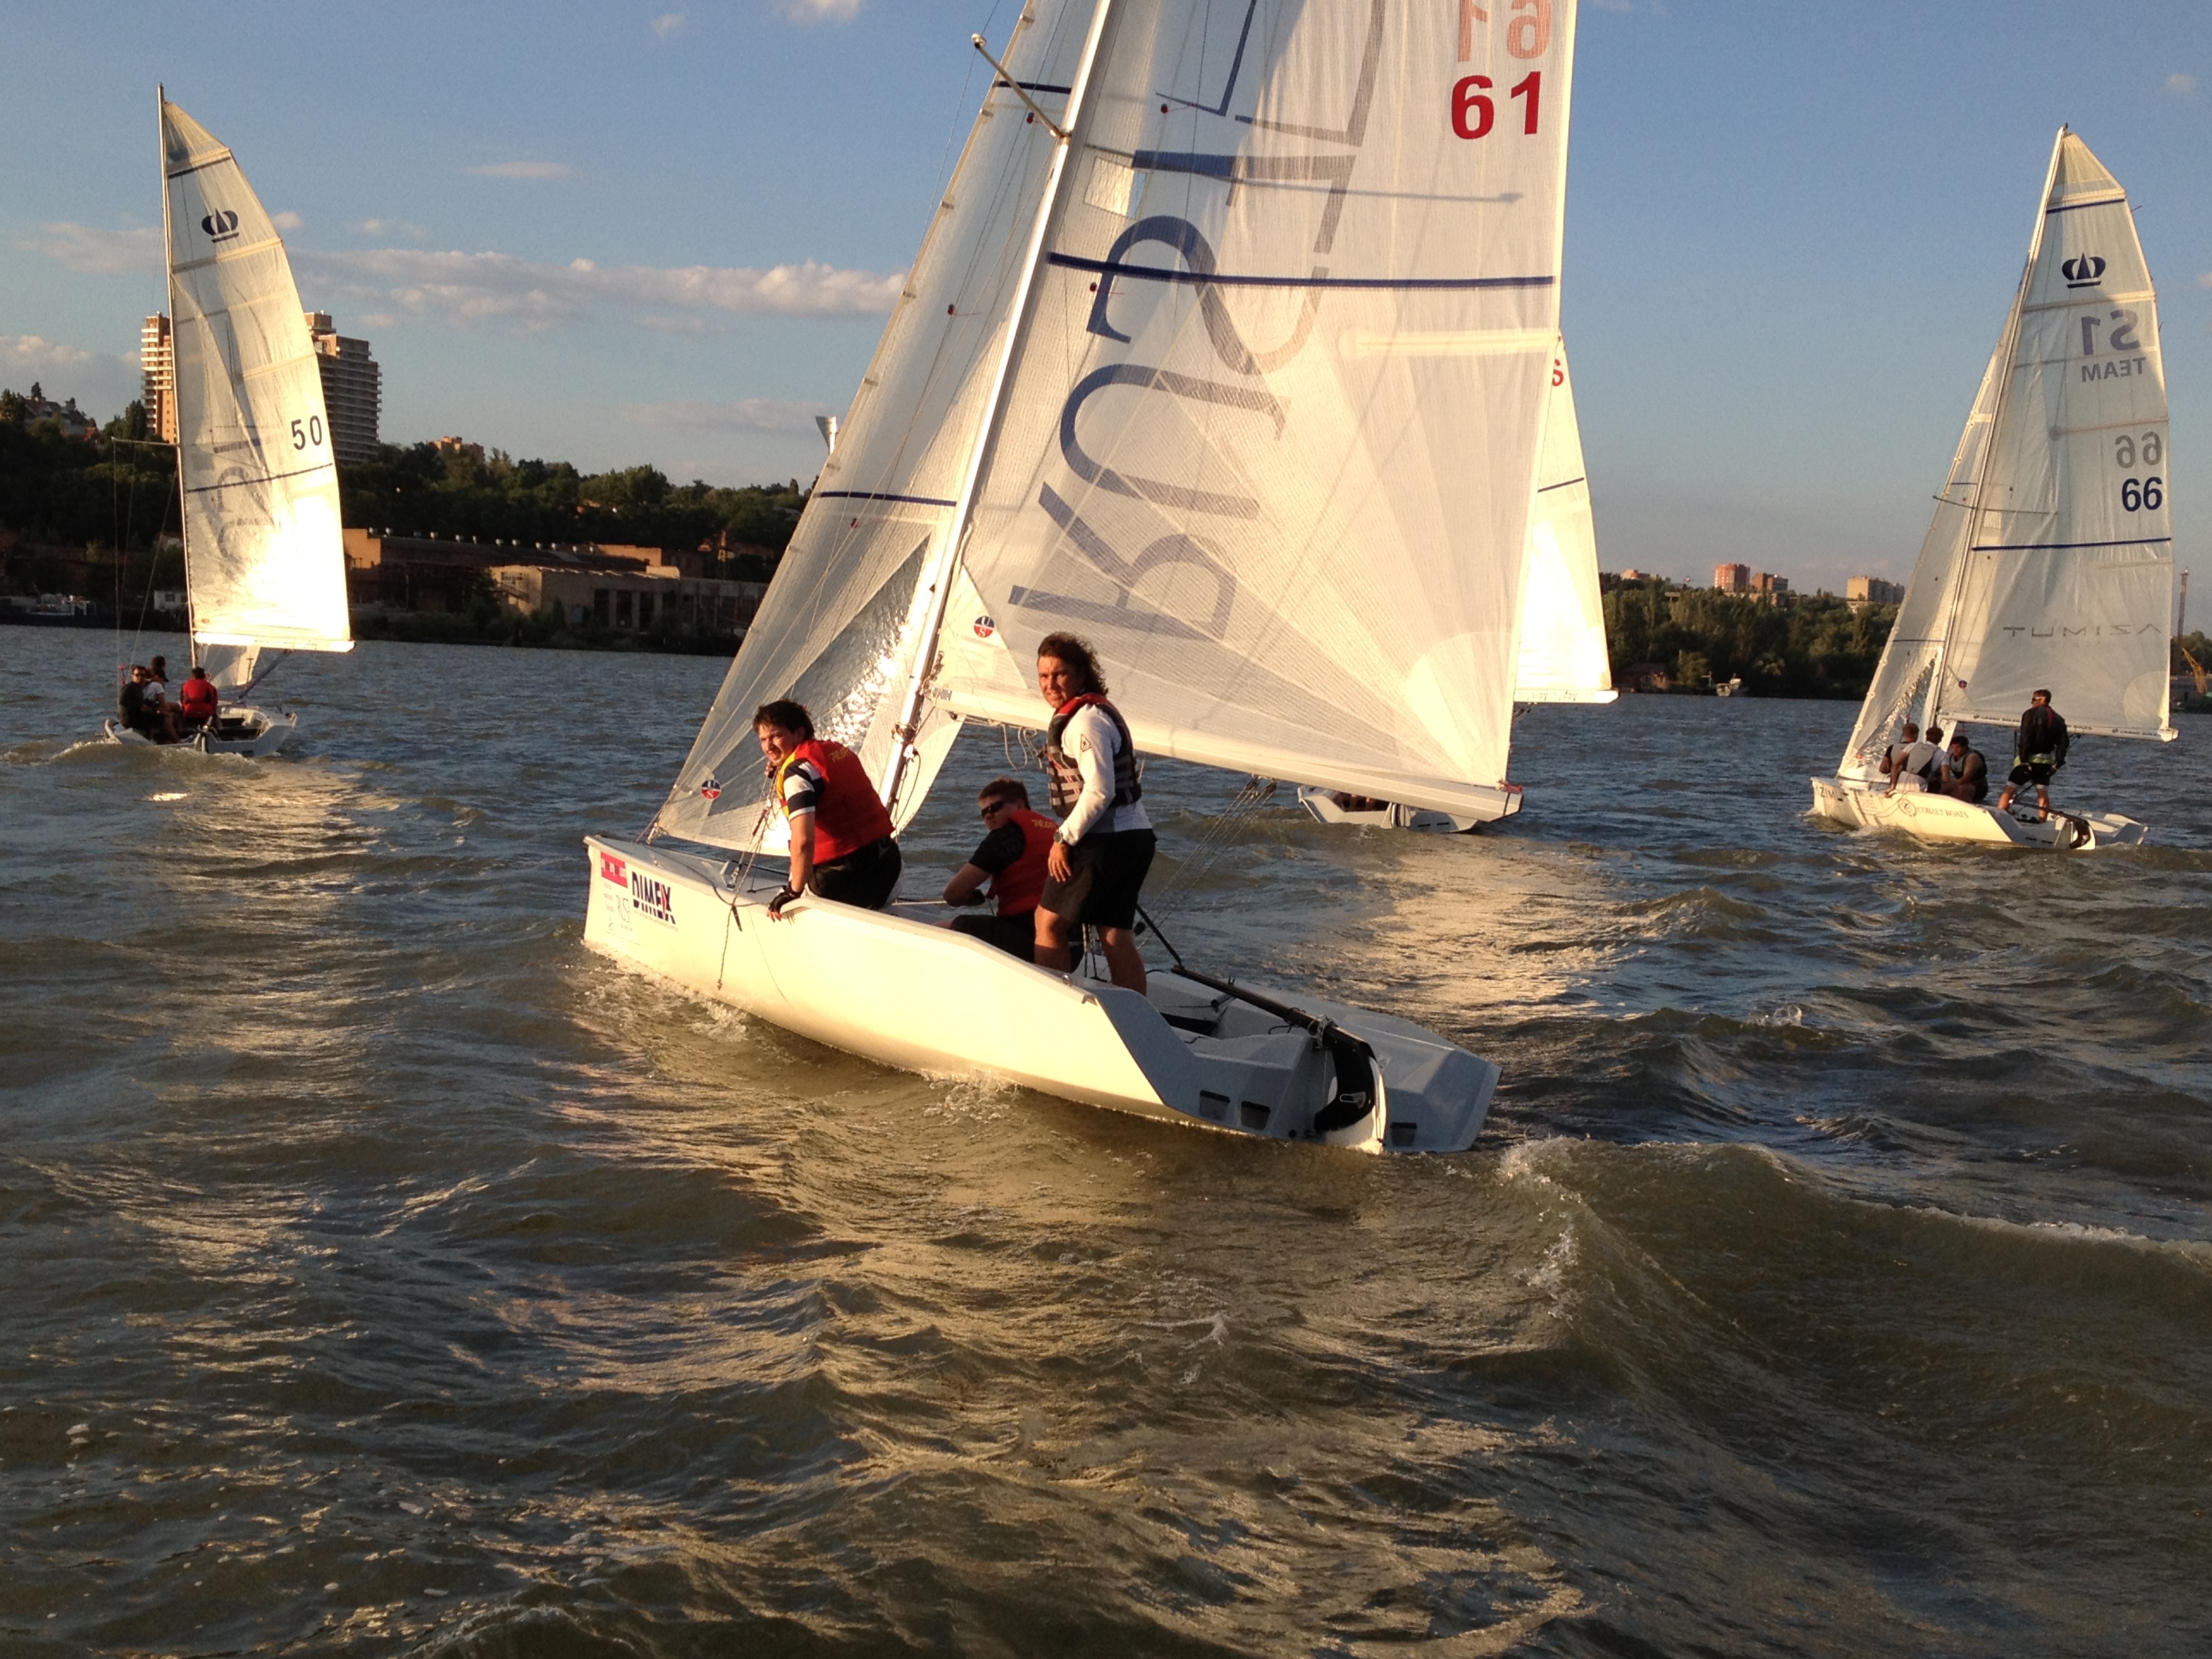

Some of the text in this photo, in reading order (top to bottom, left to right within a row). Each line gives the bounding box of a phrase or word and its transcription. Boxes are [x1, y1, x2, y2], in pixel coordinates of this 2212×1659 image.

[1451, 70, 1541, 140] 61
[291, 415, 323, 451] 50
[2122, 476, 2163, 512] 66
